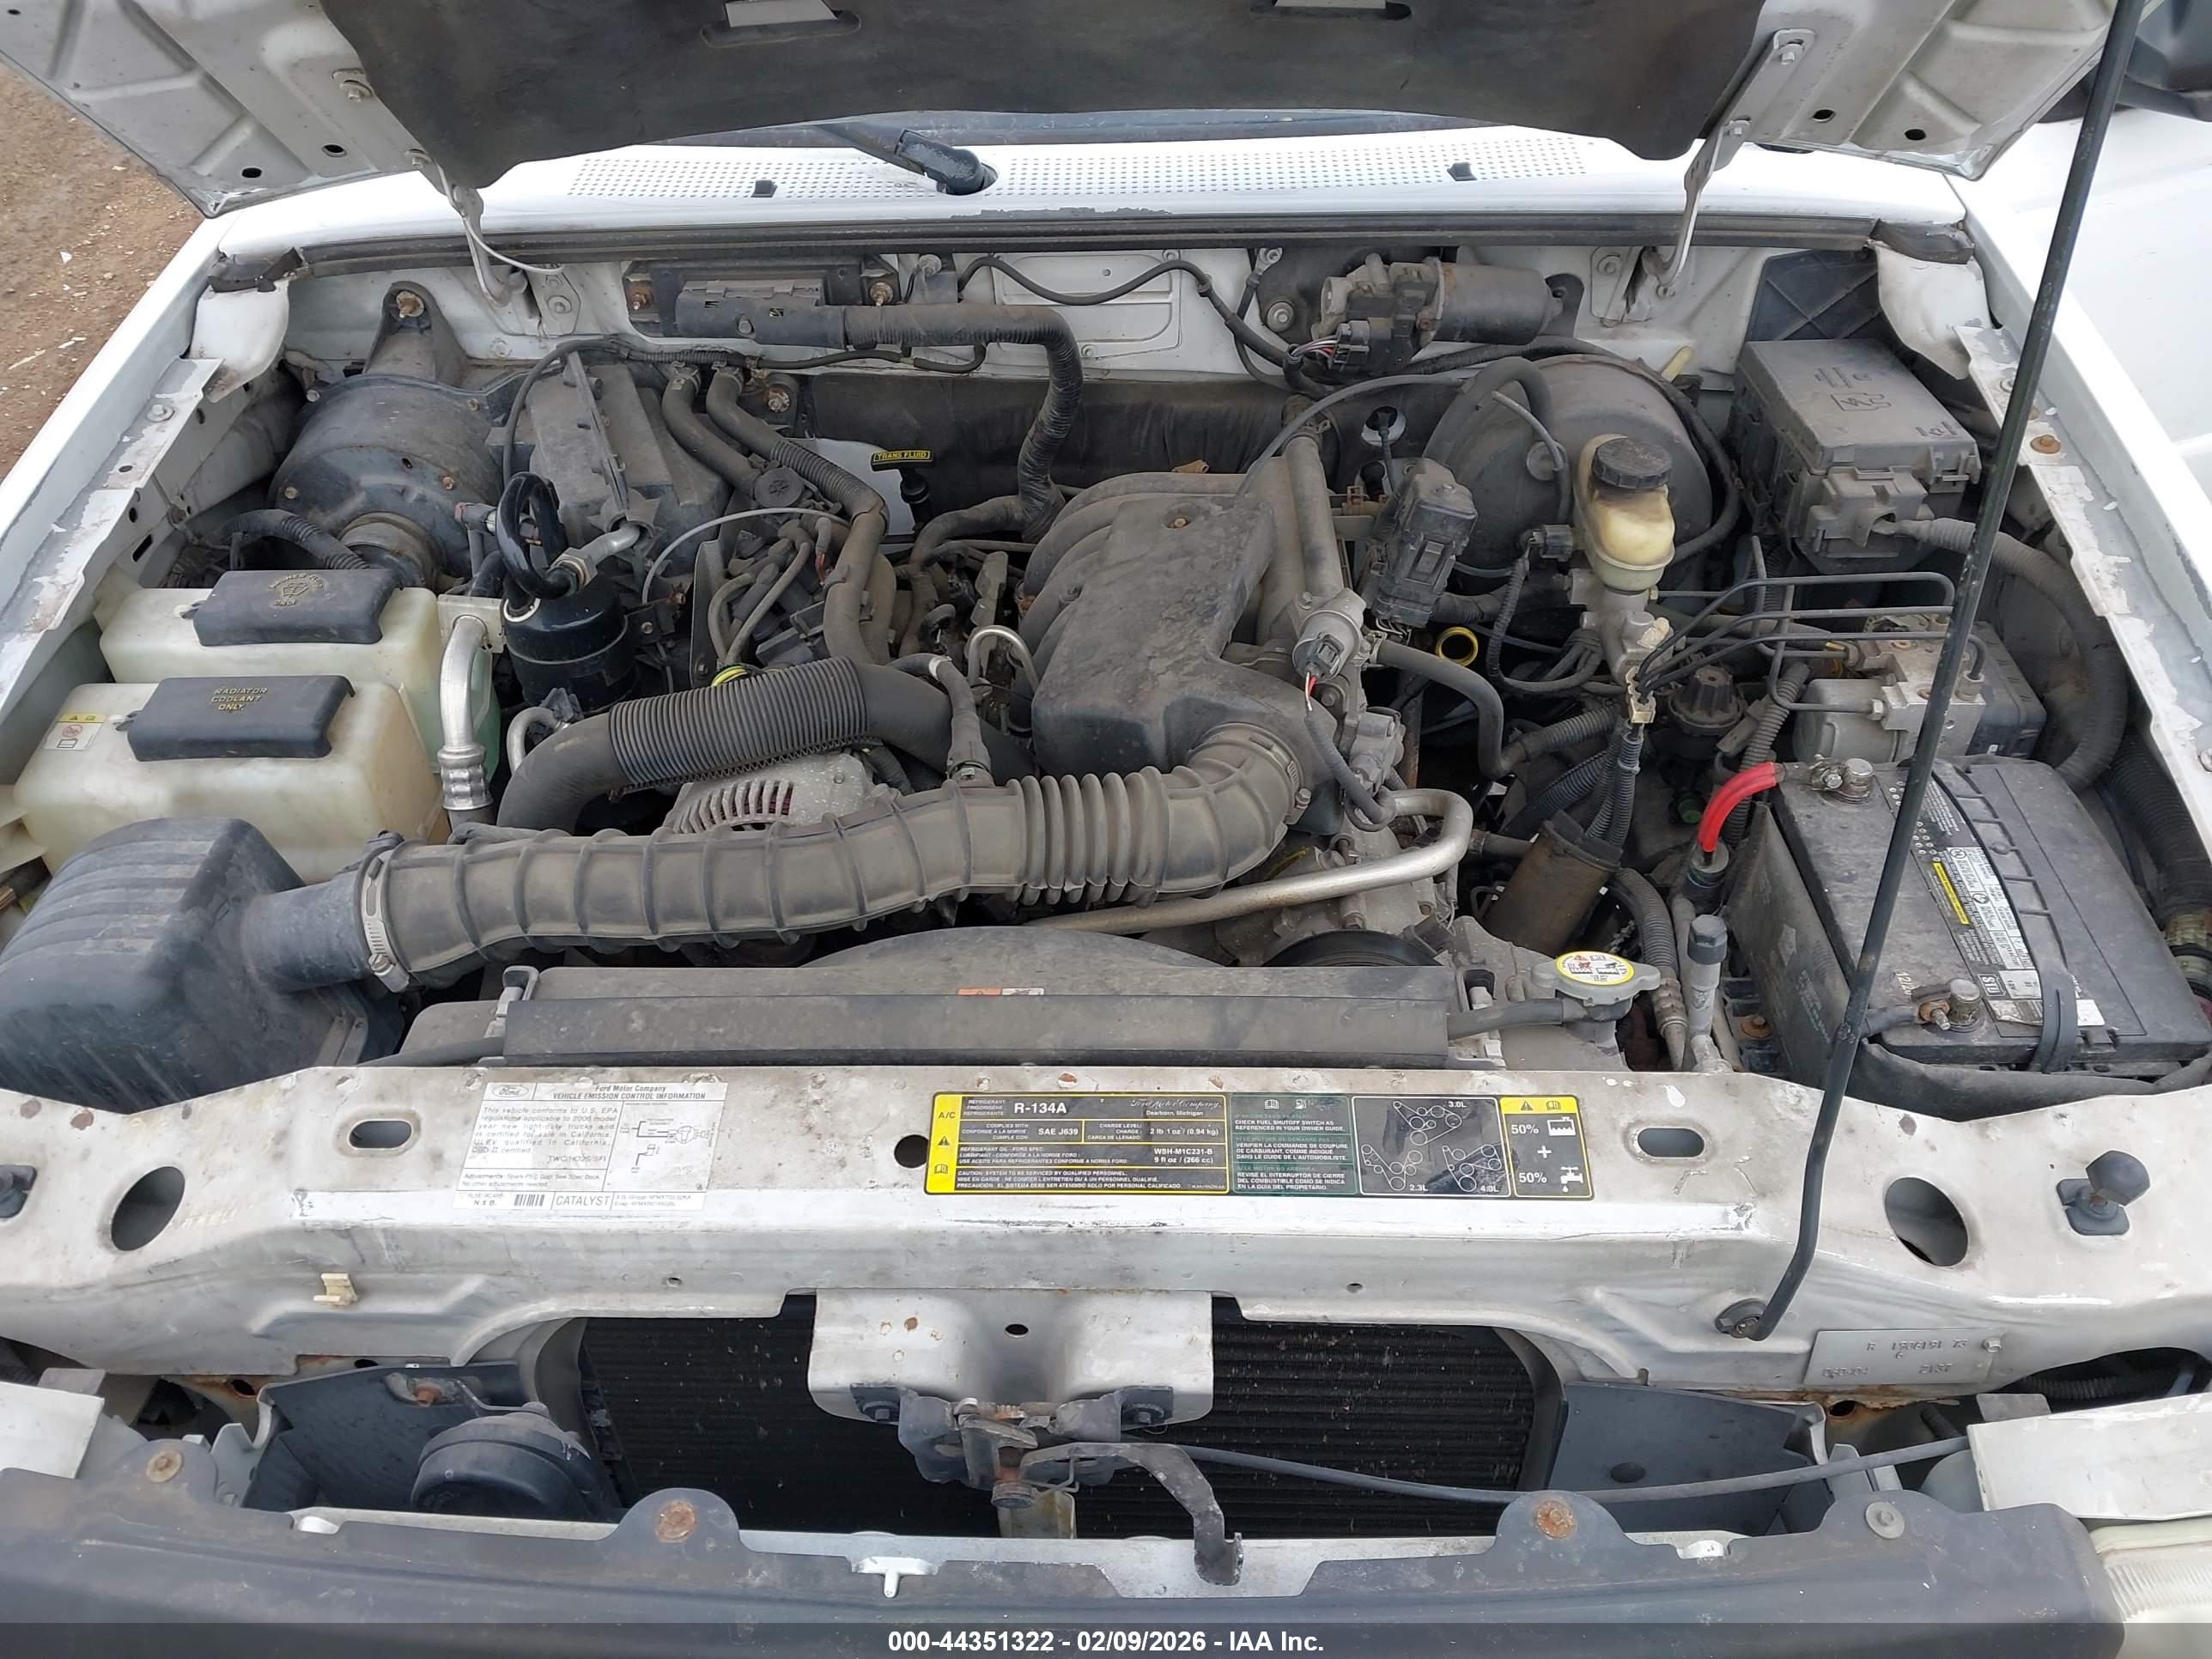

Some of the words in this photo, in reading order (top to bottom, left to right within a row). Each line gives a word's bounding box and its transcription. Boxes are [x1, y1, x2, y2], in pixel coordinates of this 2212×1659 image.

[1014, 1103, 1067, 1114] R-134A
[1511, 1125, 1540, 1134] 50%
[1518, 1173, 1547, 1183] 50%
[556, 1195, 611, 1206] CATALYST
